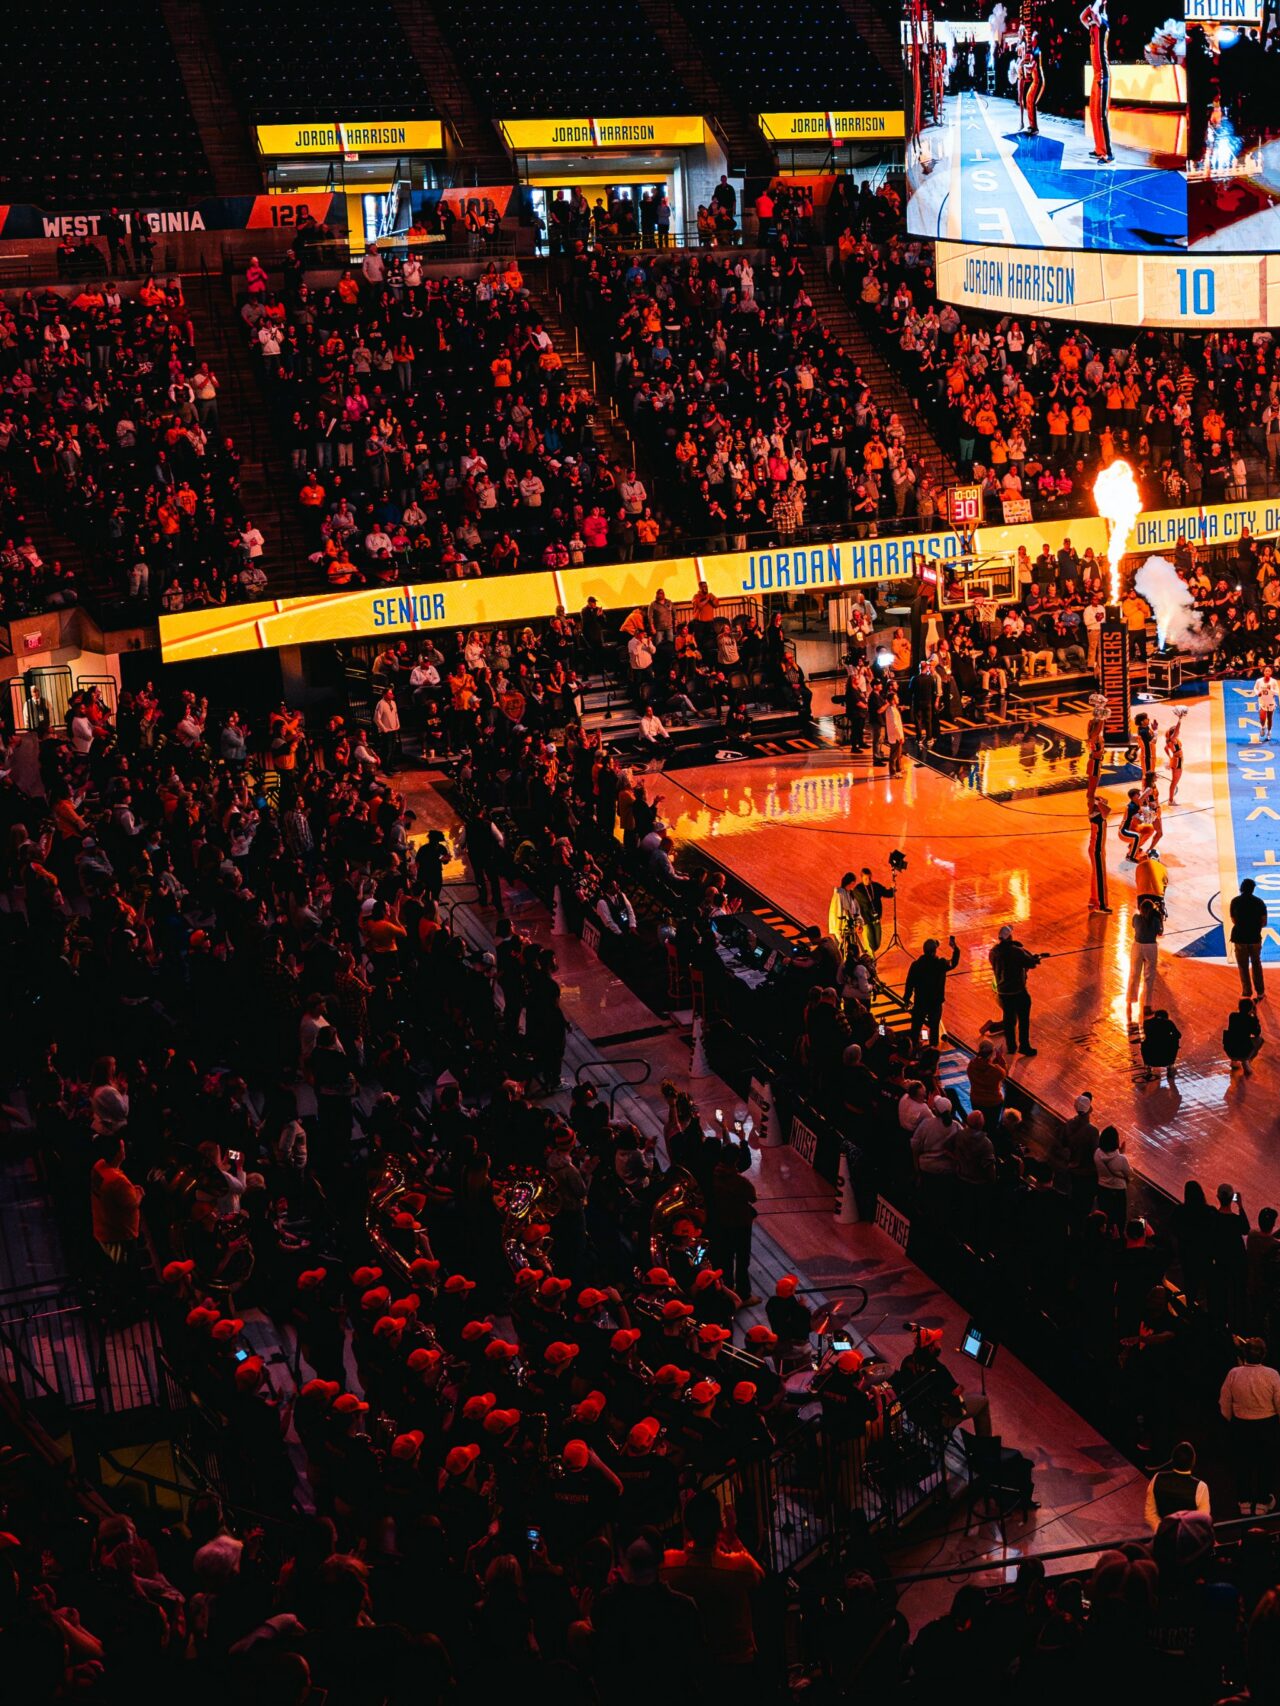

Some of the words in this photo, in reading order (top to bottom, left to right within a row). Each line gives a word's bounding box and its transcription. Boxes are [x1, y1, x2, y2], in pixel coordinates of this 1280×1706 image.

[295, 128, 342, 147] JORDAN
[347, 128, 406, 144] HARRISON
[552, 126, 596, 142] JORDAN
[600, 125, 654, 141] HARRISON
[791, 117, 831, 133] JORDAN
[835, 117, 885, 131] HARRISON
[42, 214, 101, 238] WEST
[963, 257, 1003, 298] JORDAN
[1007, 263, 1074, 305] HARRISON
[1176, 268, 1215, 315] 10
[955, 489, 978, 501] 10:00
[955, 500, 977, 520] 30
[1137, 515, 1217, 547] OKLAHOMA
[1223, 510, 1264, 542] CITY,
[742, 542, 842, 591] JORDAN
[373, 593, 446, 627] SENIOR
[1103, 631, 1124, 734] MOUNTAINEERS
[791, 1117, 817, 1168] NOISE
[873, 1196, 911, 1250] DEFENSE
